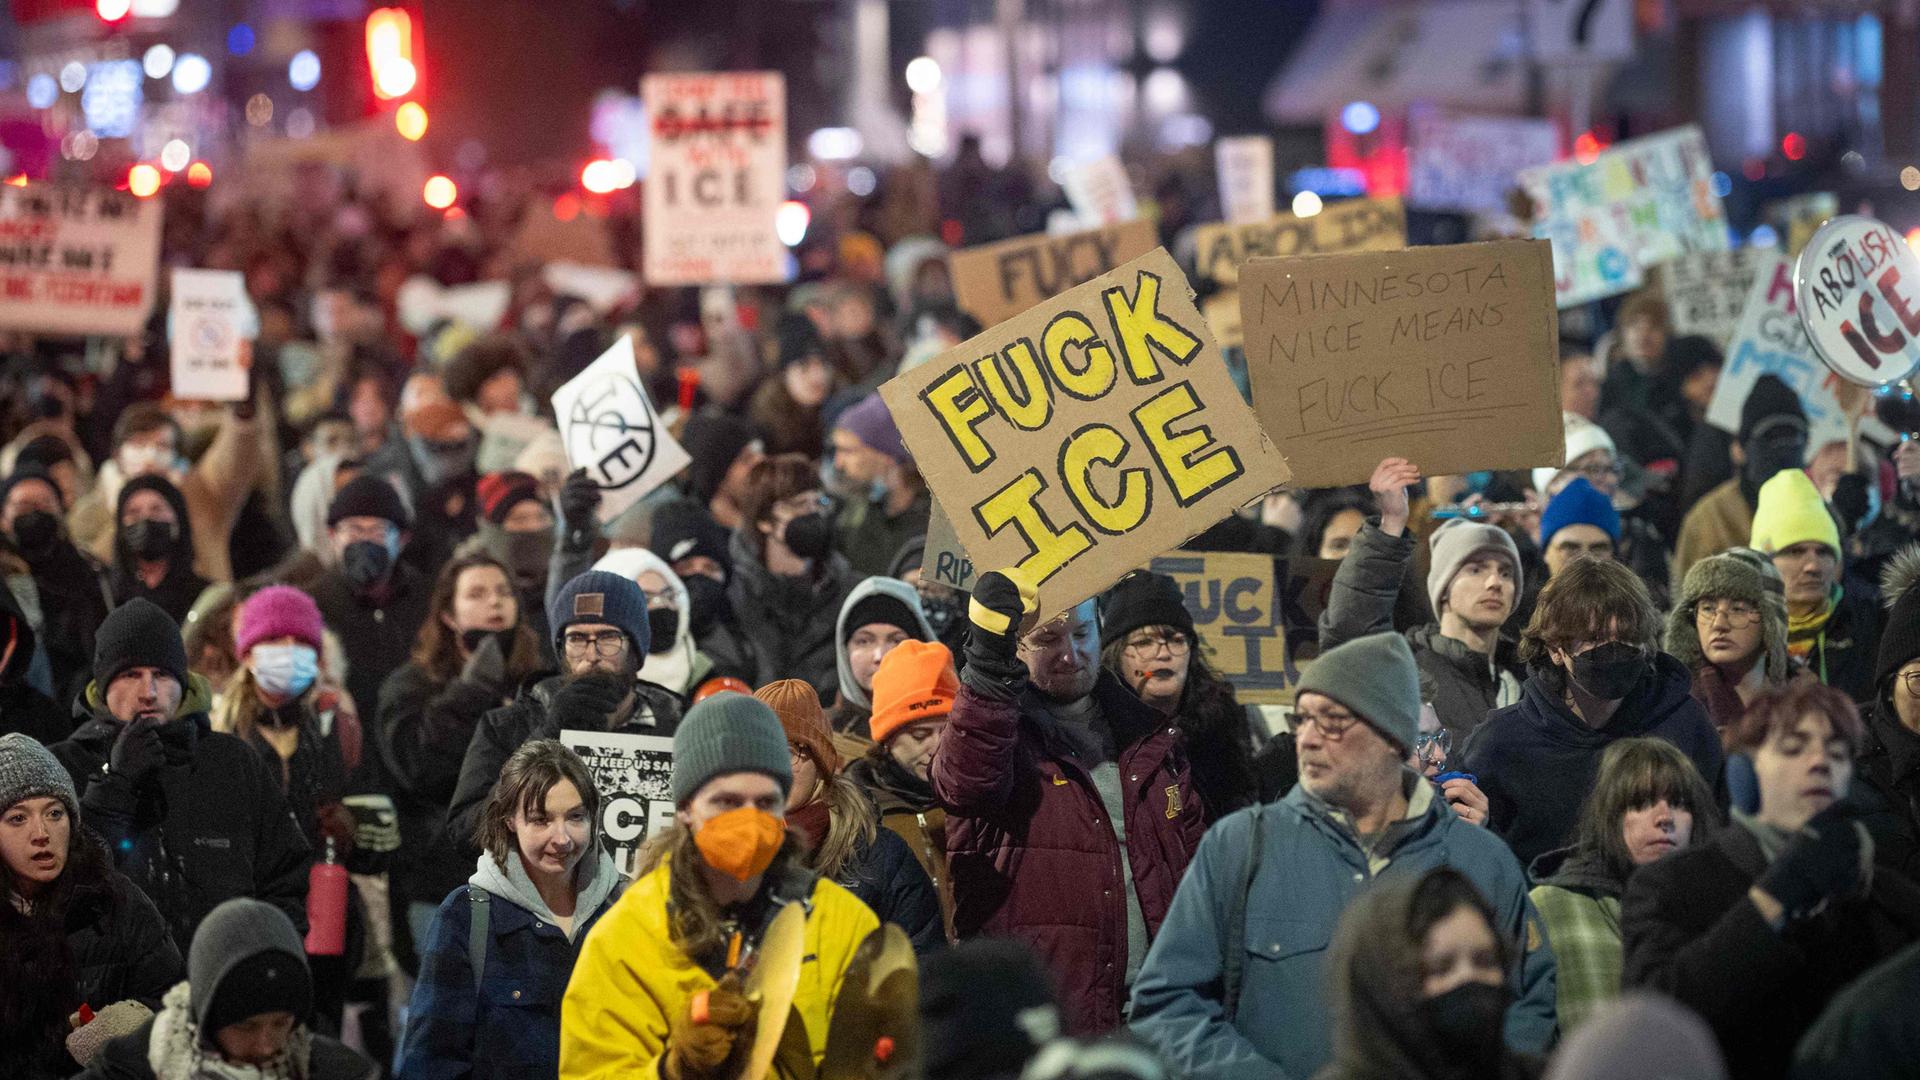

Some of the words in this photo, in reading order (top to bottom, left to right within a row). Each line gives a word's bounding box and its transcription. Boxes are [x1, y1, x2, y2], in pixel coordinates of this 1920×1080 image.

[1260, 263, 1508, 325] MINNESOTA
[1812, 224, 1900, 320] ABOLISH
[1269, 321, 1364, 364] NICE
[1390, 302, 1509, 345] MEANS
[1840, 265, 1920, 370] ICE
[917, 270, 1204, 474] FUCK
[1297, 371, 1399, 433] FUCK
[1426, 356, 1493, 408] ICE
[971, 379, 1246, 588] ICE
[935, 551, 973, 587] RIP
[600, 757, 633, 769] KEEP
[634, 759, 652, 770] US
